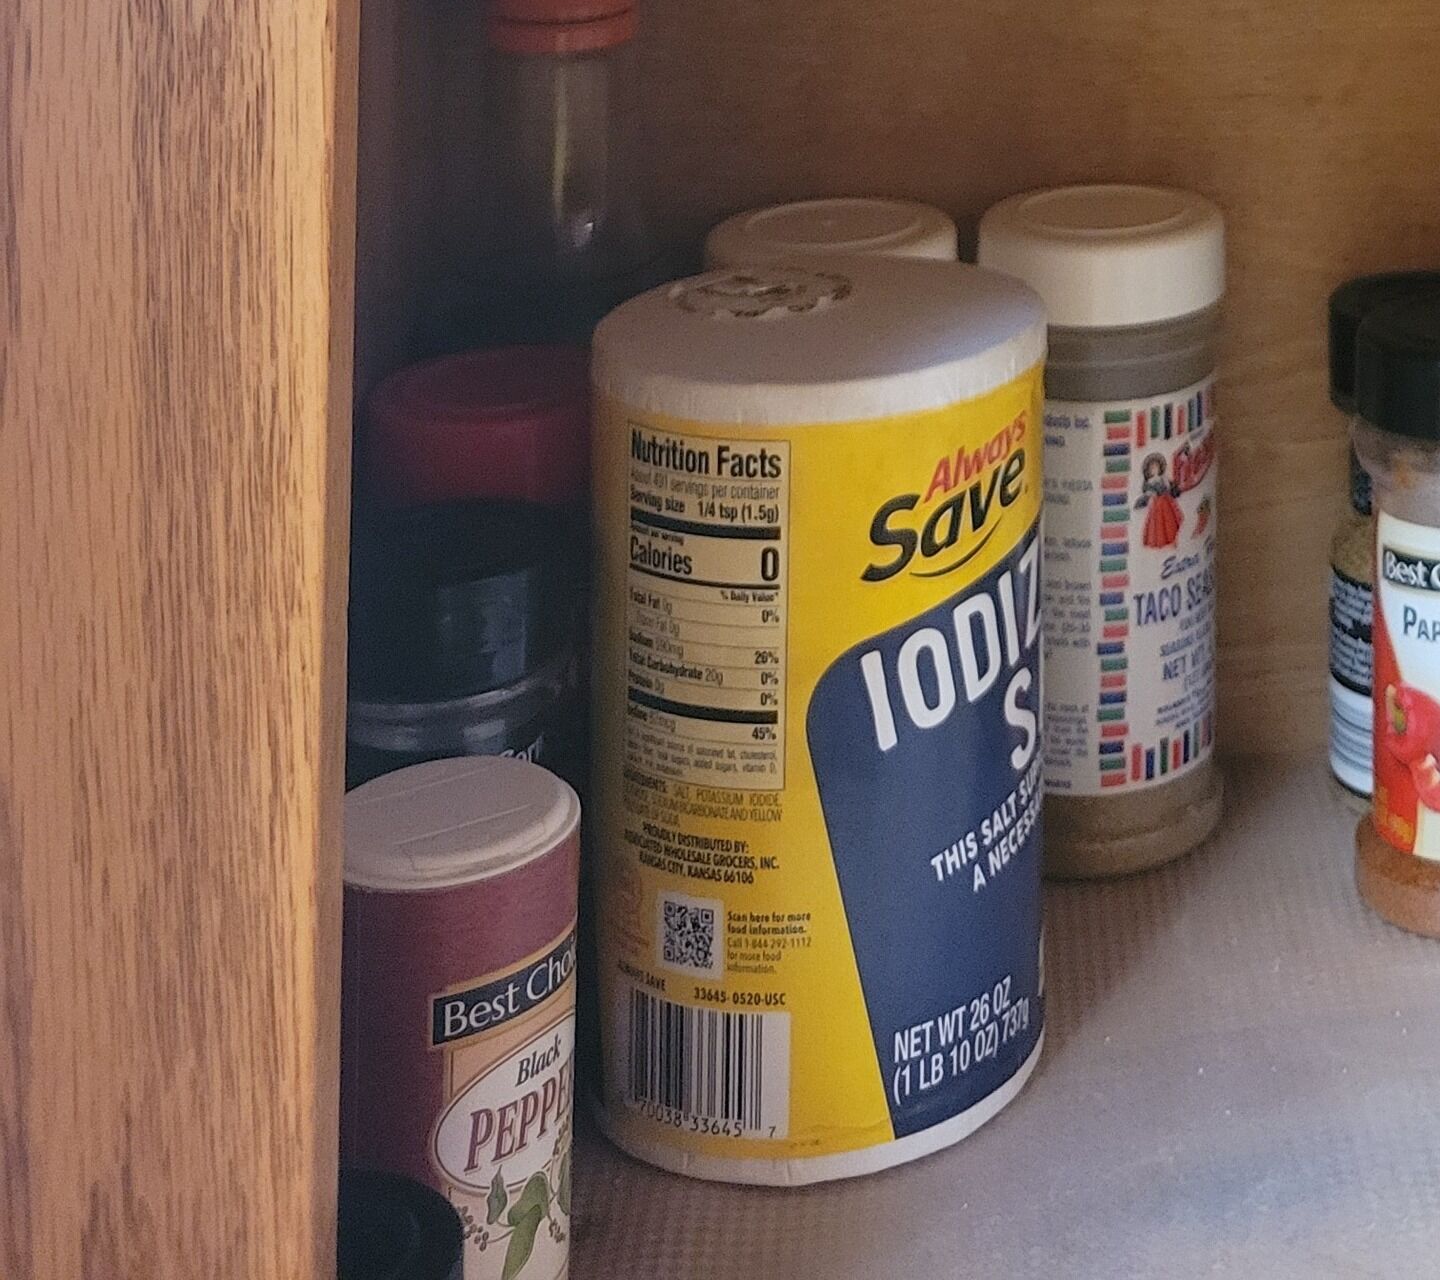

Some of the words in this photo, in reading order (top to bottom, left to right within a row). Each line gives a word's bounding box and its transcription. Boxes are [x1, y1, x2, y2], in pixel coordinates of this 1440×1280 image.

[631, 427, 710, 475] Nutrition
[716, 445, 782, 479] Facts
[922, 410, 1028, 504] Always
[630, 487, 663, 513] Serving
[665, 495, 685, 513] size
[698, 500, 716, 518] 1/4
[719, 502, 738, 523] tsp
[741, 502, 780, 524] (1.5g)
[711, 484, 728, 500] per
[730, 483, 780, 501] container
[860, 447, 1027, 583] Save
[630, 535, 693, 575] Calories
[761, 546, 780, 581] 0
[1383, 549, 1429, 588] Best
[761, 609, 780, 624] 0%
[1133, 582, 1182, 627] TACO
[646, 656, 703, 681] Carbohydrate
[760, 671, 779, 686] 0%
[760, 692, 779, 706] 0%
[752, 726, 777, 741] 45%
[677, 831, 733, 852] DISTRIBUTED
[733, 840, 750, 854] BY:
[930, 831, 978, 881] THIS
[981, 790, 1017, 846] SALT
[663, 843, 712, 866] WHOLESALE
[712, 853, 758, 871] GROCERS,
[760, 856, 780, 870] INC.
[687, 865, 722, 882] KANSAS
[723, 870, 755, 885] 66106
[973, 862, 987, 892] A
[727, 910, 748, 922] Scan
[749, 910, 770, 923] here
[771, 910, 785, 922] for
[787, 911, 811, 922] more
[727, 921, 747, 935] food
[761, 949, 782, 961] food
[645, 973, 666, 991] SAVE
[443, 984, 521, 1039] Best
[894, 1020, 934, 1064] NET
[938, 1005, 966, 1047] WT
[969, 992, 990, 1031] 26
[993, 974, 1012, 1016] OZ
[515, 1032, 562, 1088] Black
[893, 1063, 911, 1106] (1
[919, 1052, 944, 1090] LB
[950, 1039, 971, 1076] 10
[974, 1021, 999, 1062] OZ)
[463, 1051, 574, 1174] PEPPE
[768, 1125, 777, 1138] 7
